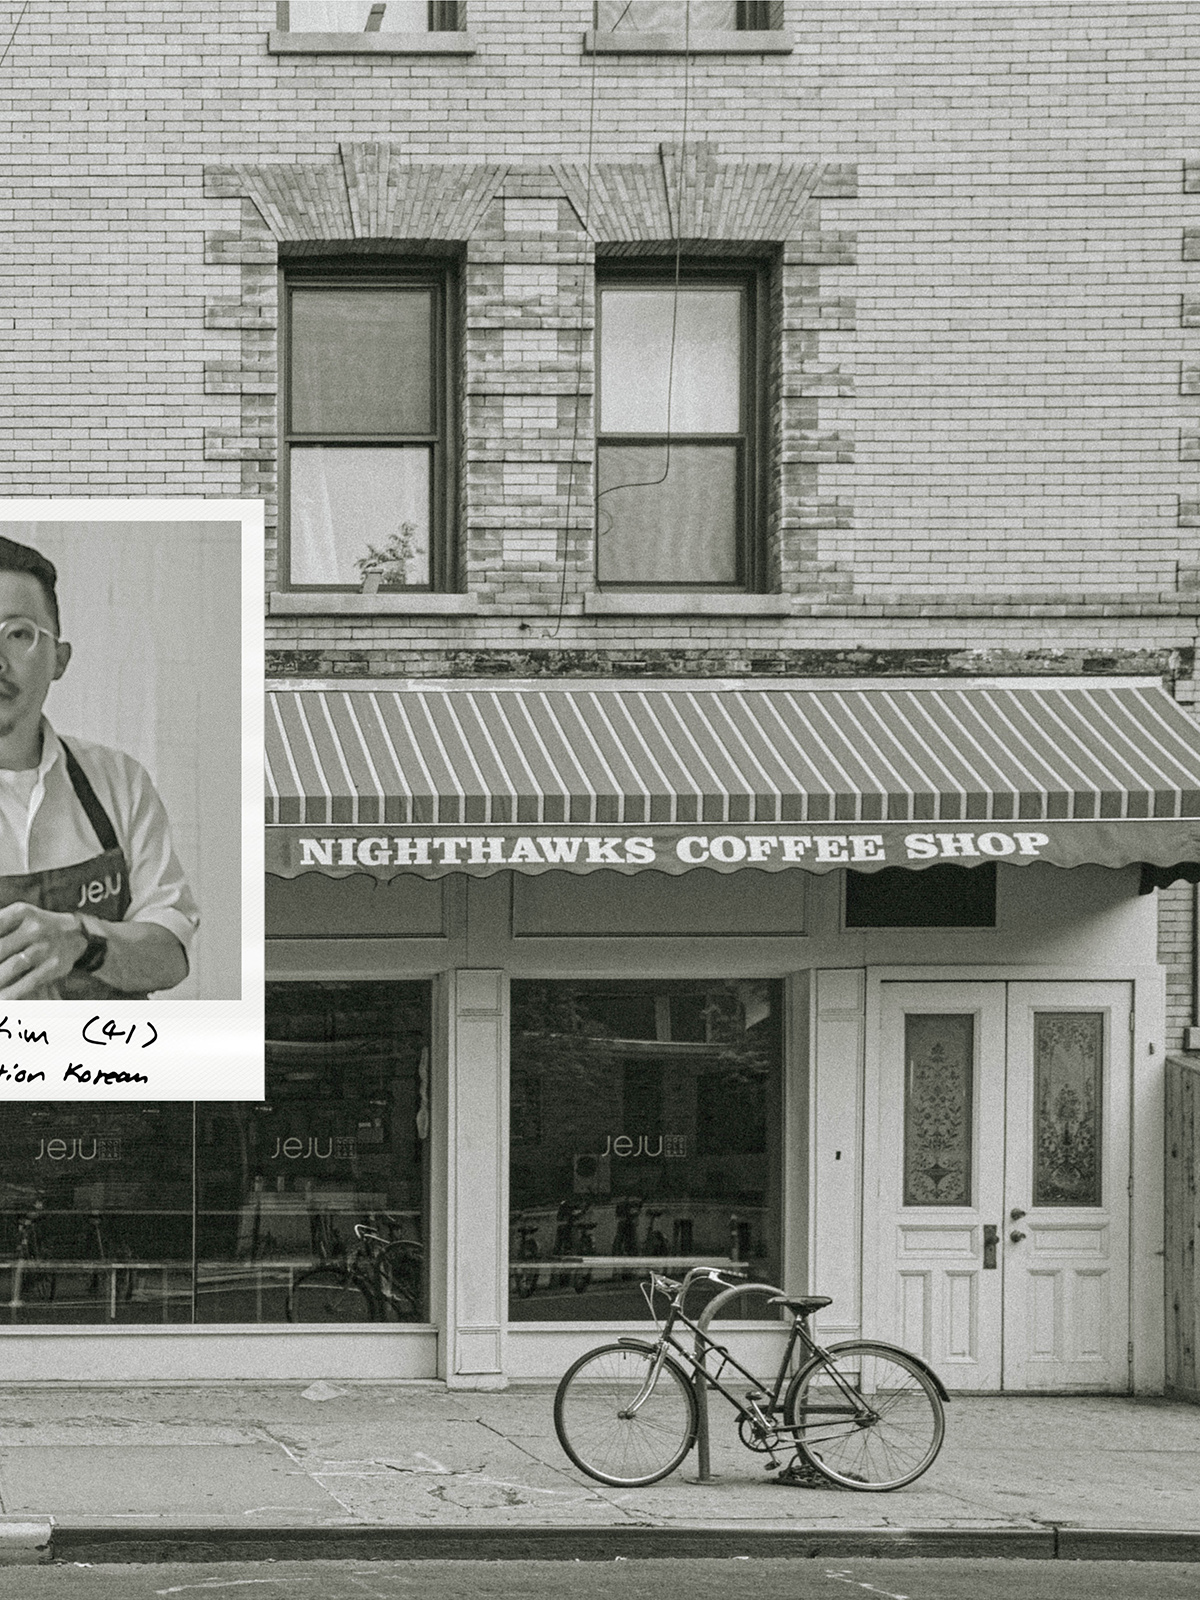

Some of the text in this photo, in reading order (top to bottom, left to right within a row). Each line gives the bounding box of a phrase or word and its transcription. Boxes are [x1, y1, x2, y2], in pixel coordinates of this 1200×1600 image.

[299, 832, 1050, 866] NIGHTHAWKS COFFEE SHOP
